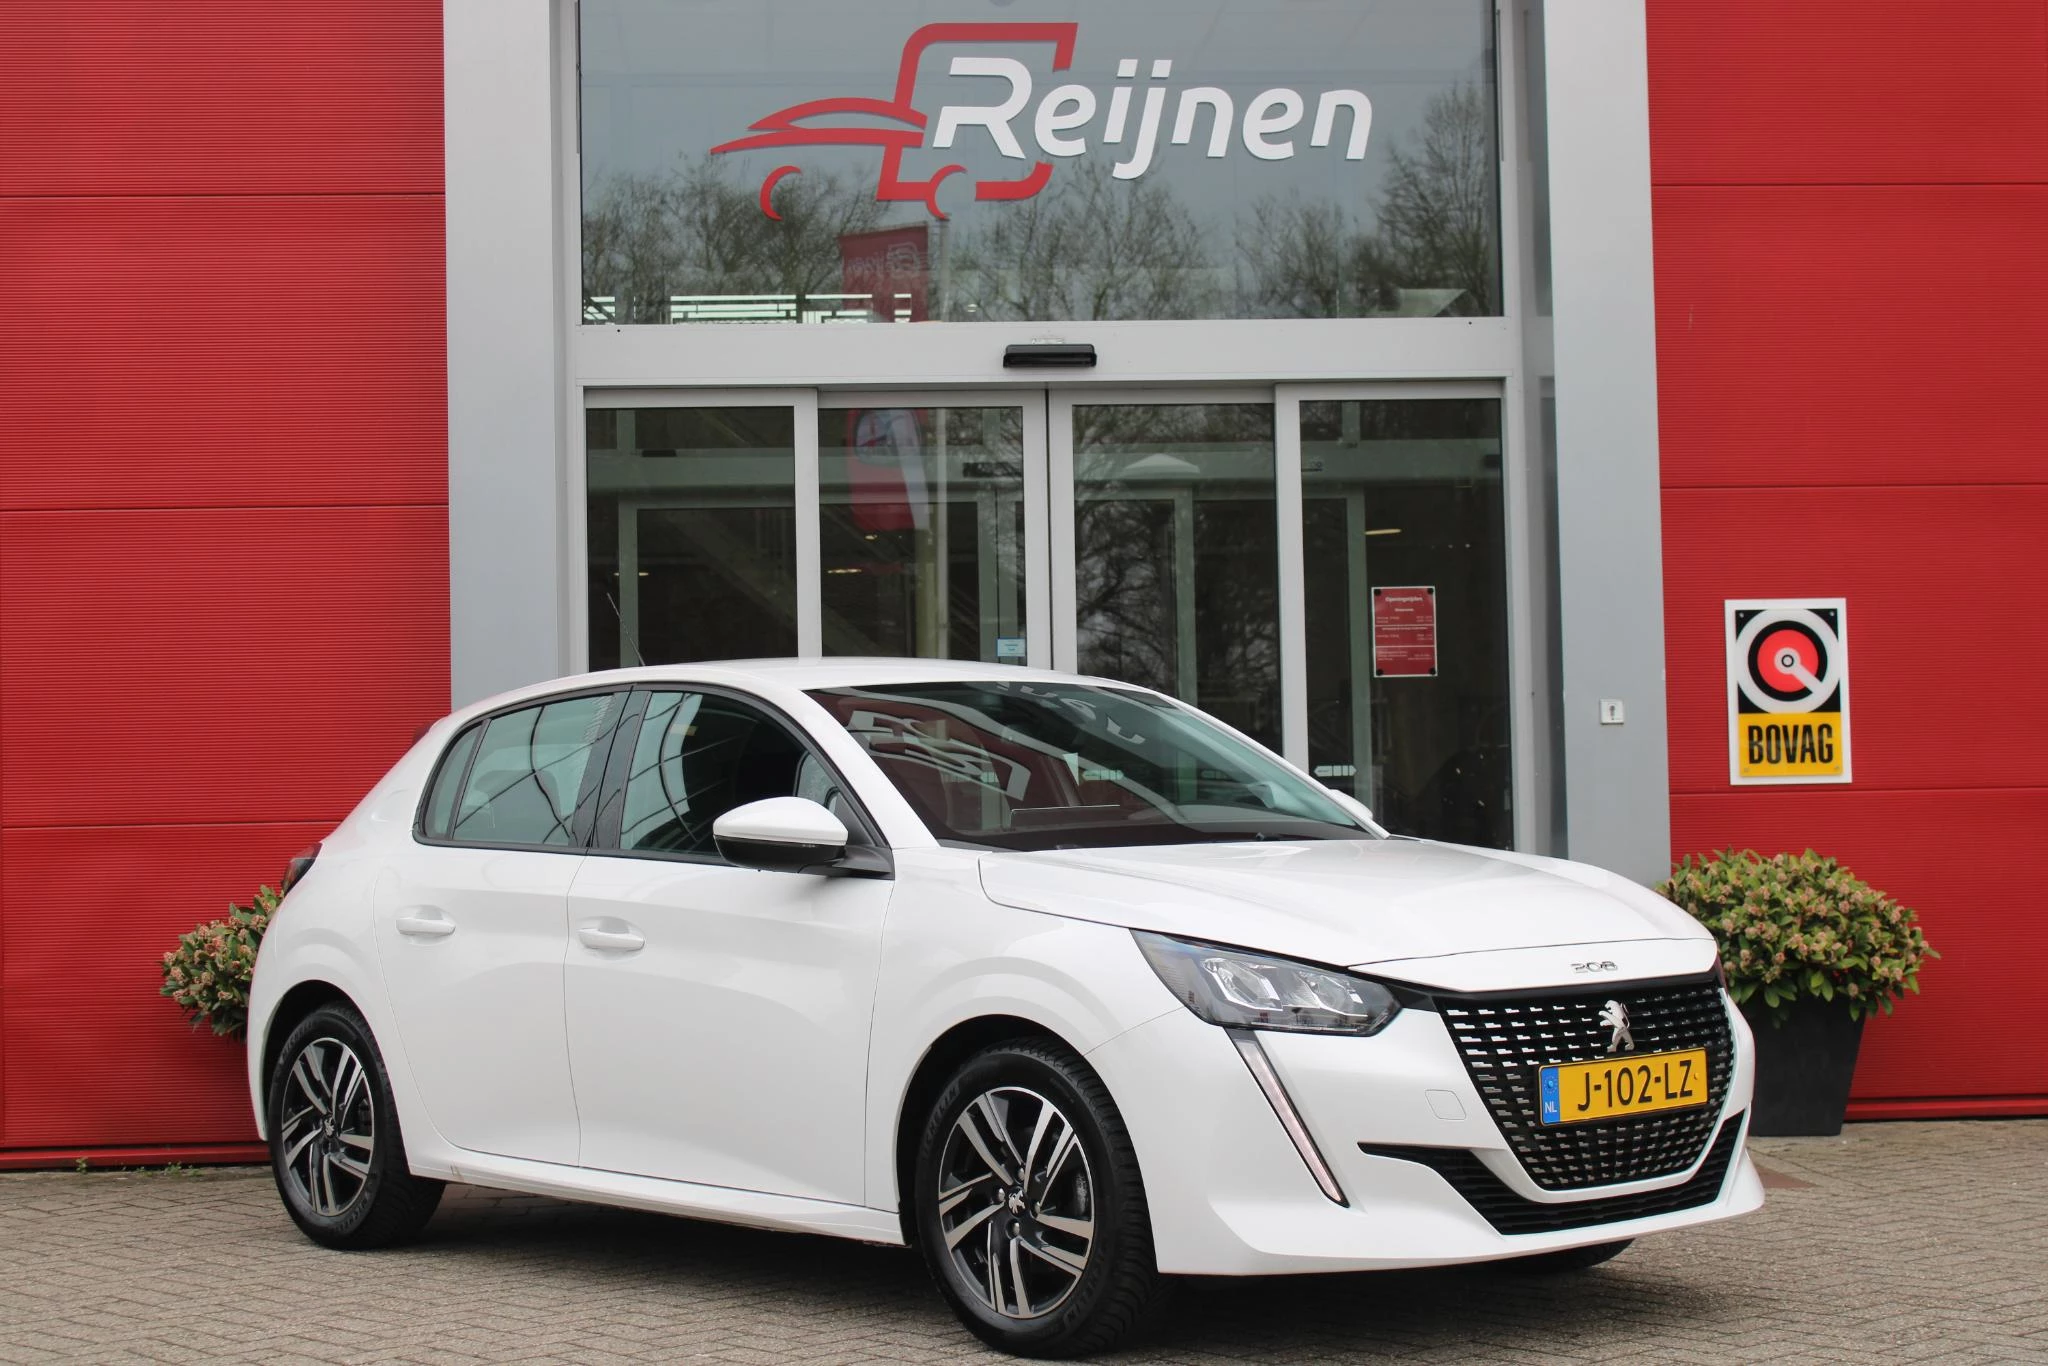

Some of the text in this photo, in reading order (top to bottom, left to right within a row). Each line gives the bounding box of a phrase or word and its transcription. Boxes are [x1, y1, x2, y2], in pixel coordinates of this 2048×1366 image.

[933, 56, 1373, 181] Reijnen
[1748, 723, 1834, 764] BOVAG
[1570, 961, 1618, 974] 208
[1577, 1060, 1694, 1111] J-102-LZ
[1544, 1101, 1558, 1114] NL
